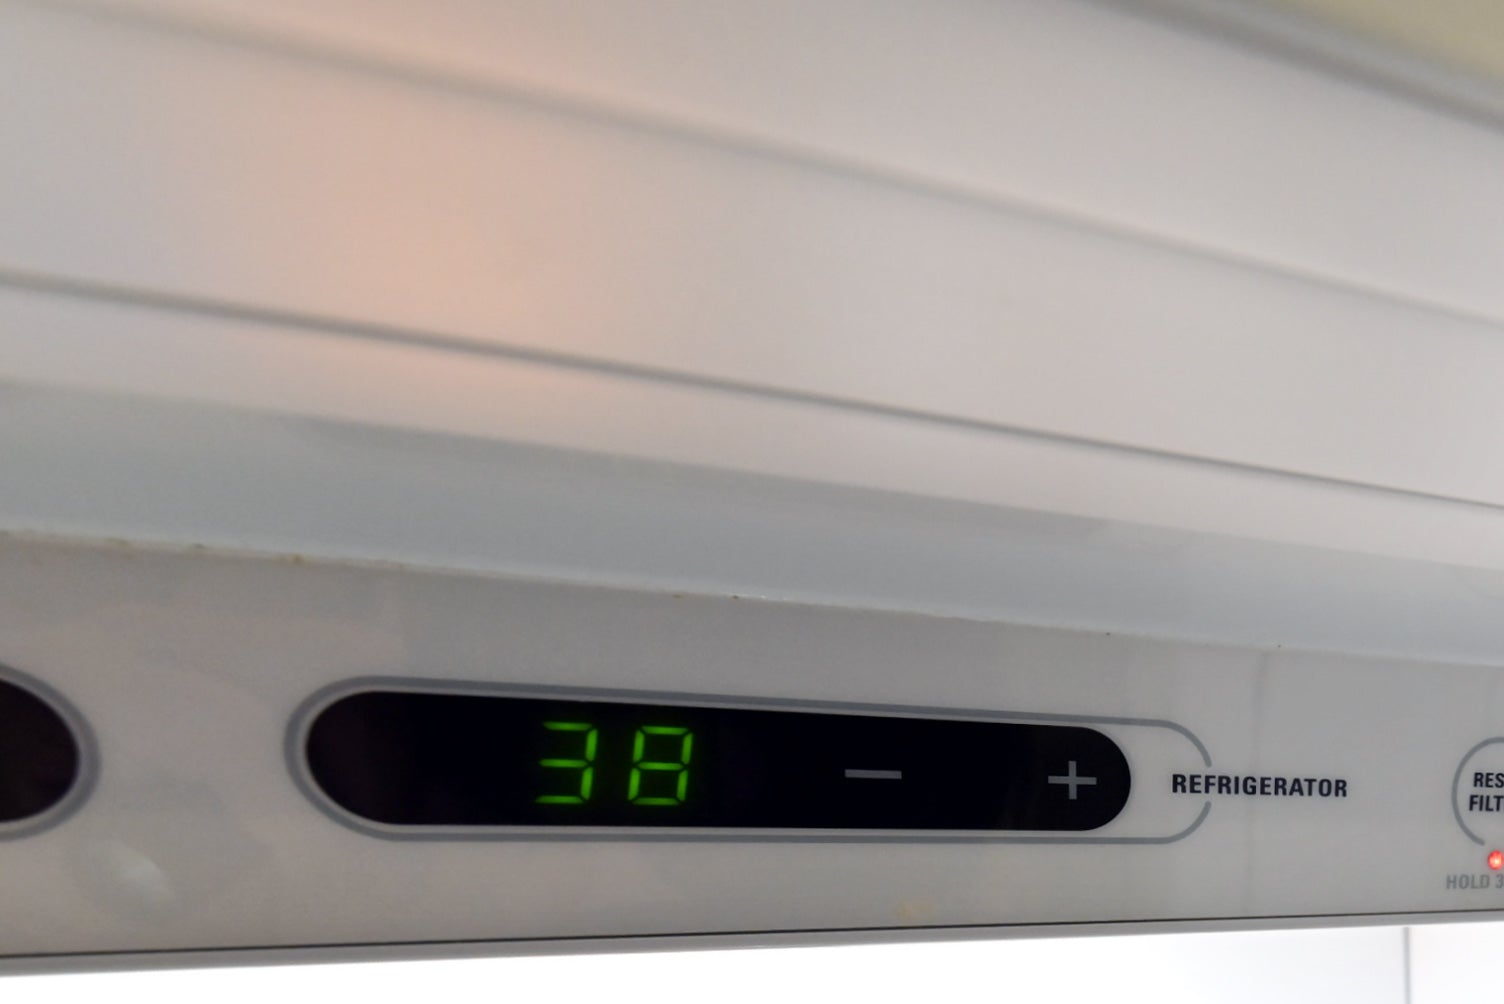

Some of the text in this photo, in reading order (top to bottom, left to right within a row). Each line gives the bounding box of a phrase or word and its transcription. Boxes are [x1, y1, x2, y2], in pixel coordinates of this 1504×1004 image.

[535, 721, 693, 806] 38
[1171, 774, 1348, 798] REFRIGERATOR
[1446, 874, 1489, 890] HOLD
[1496, 874, 1504, 888] 3
